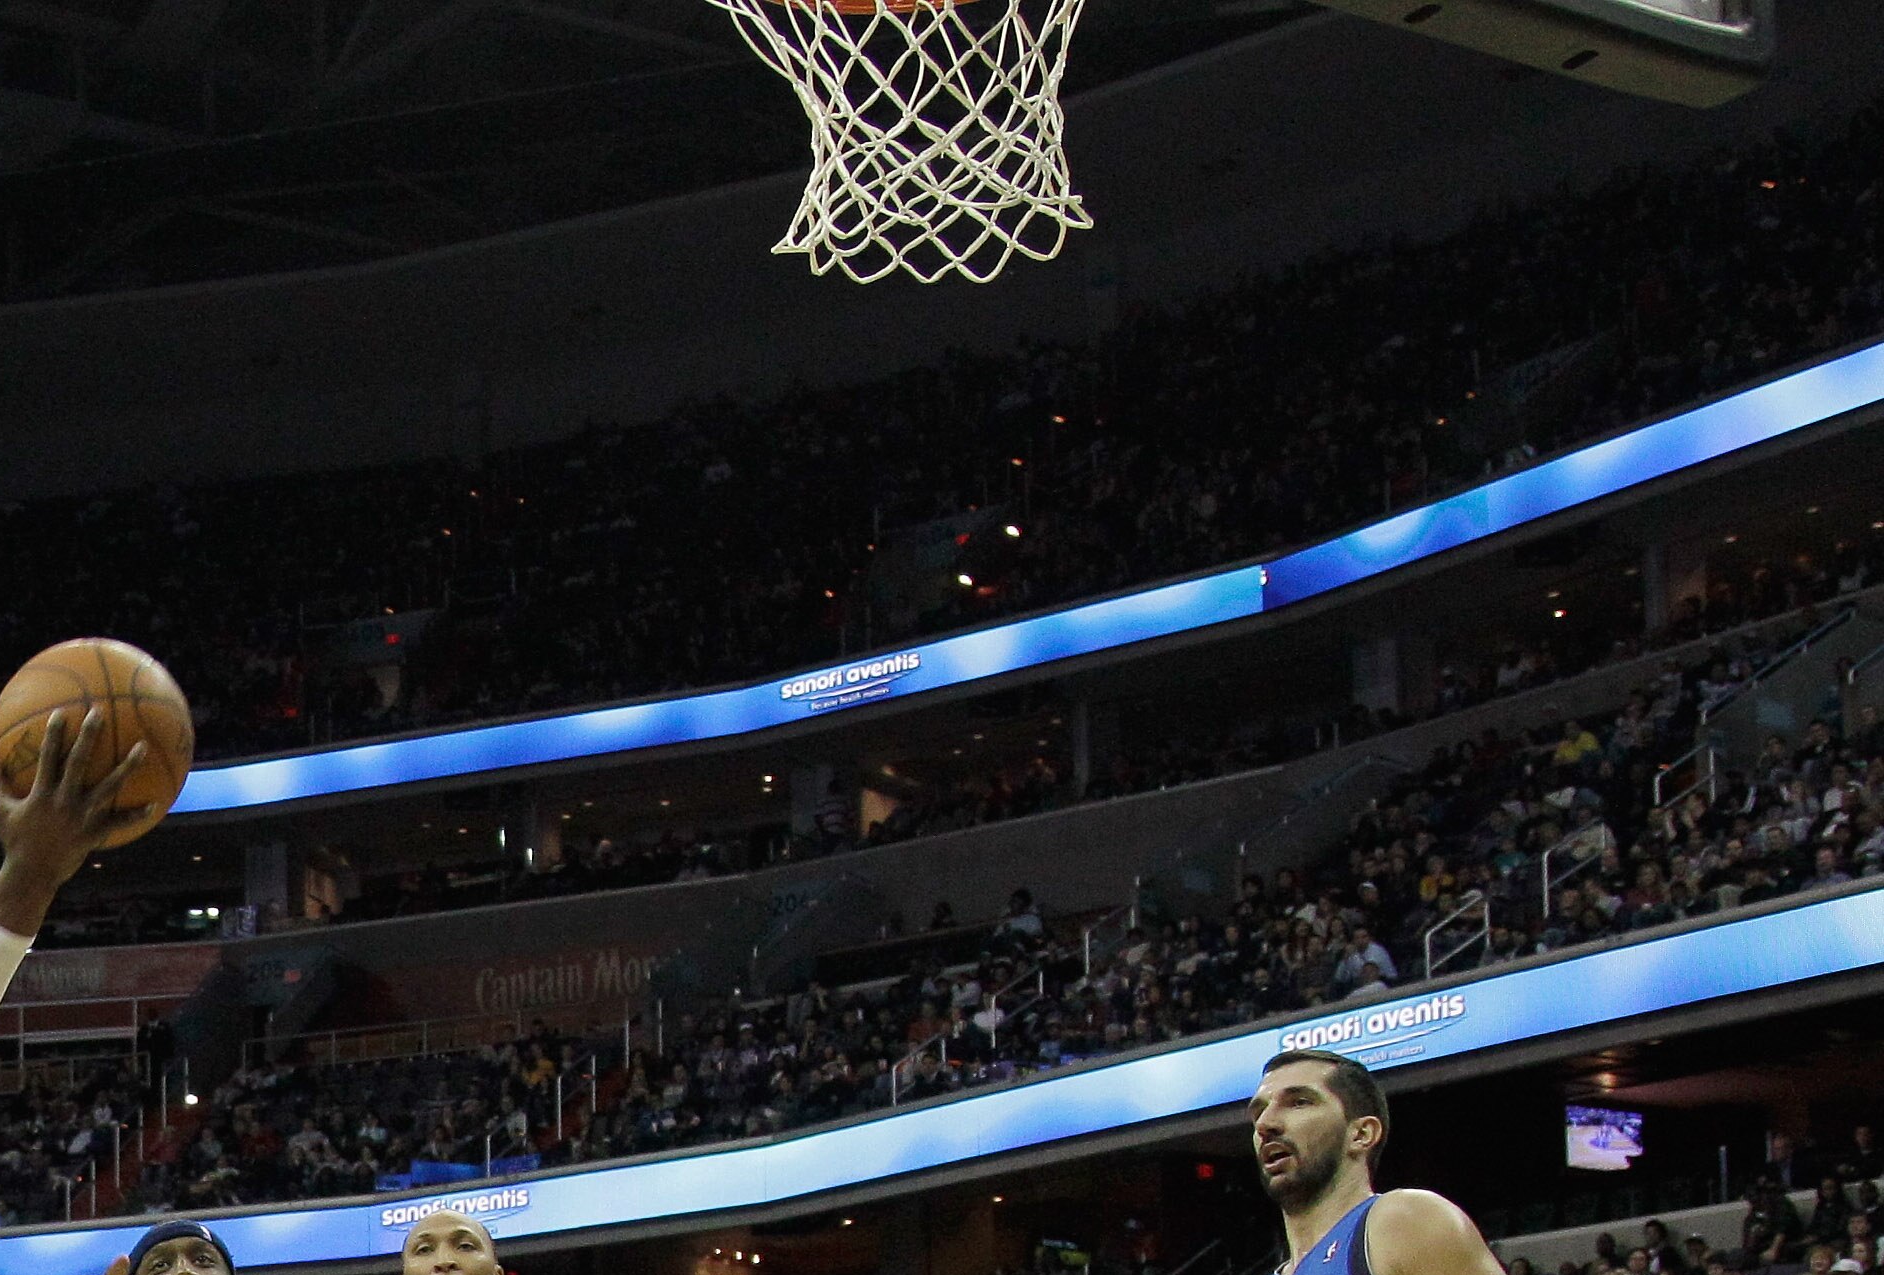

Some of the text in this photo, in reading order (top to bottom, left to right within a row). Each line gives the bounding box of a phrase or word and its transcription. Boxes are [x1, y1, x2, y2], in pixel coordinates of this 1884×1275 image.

[781, 653, 920, 699] sanofi aventis
[594, 949, 657, 997] Mor
[1282, 994, 1465, 1051] sanofi aventis
[451, 1190, 529, 1214] aventis
